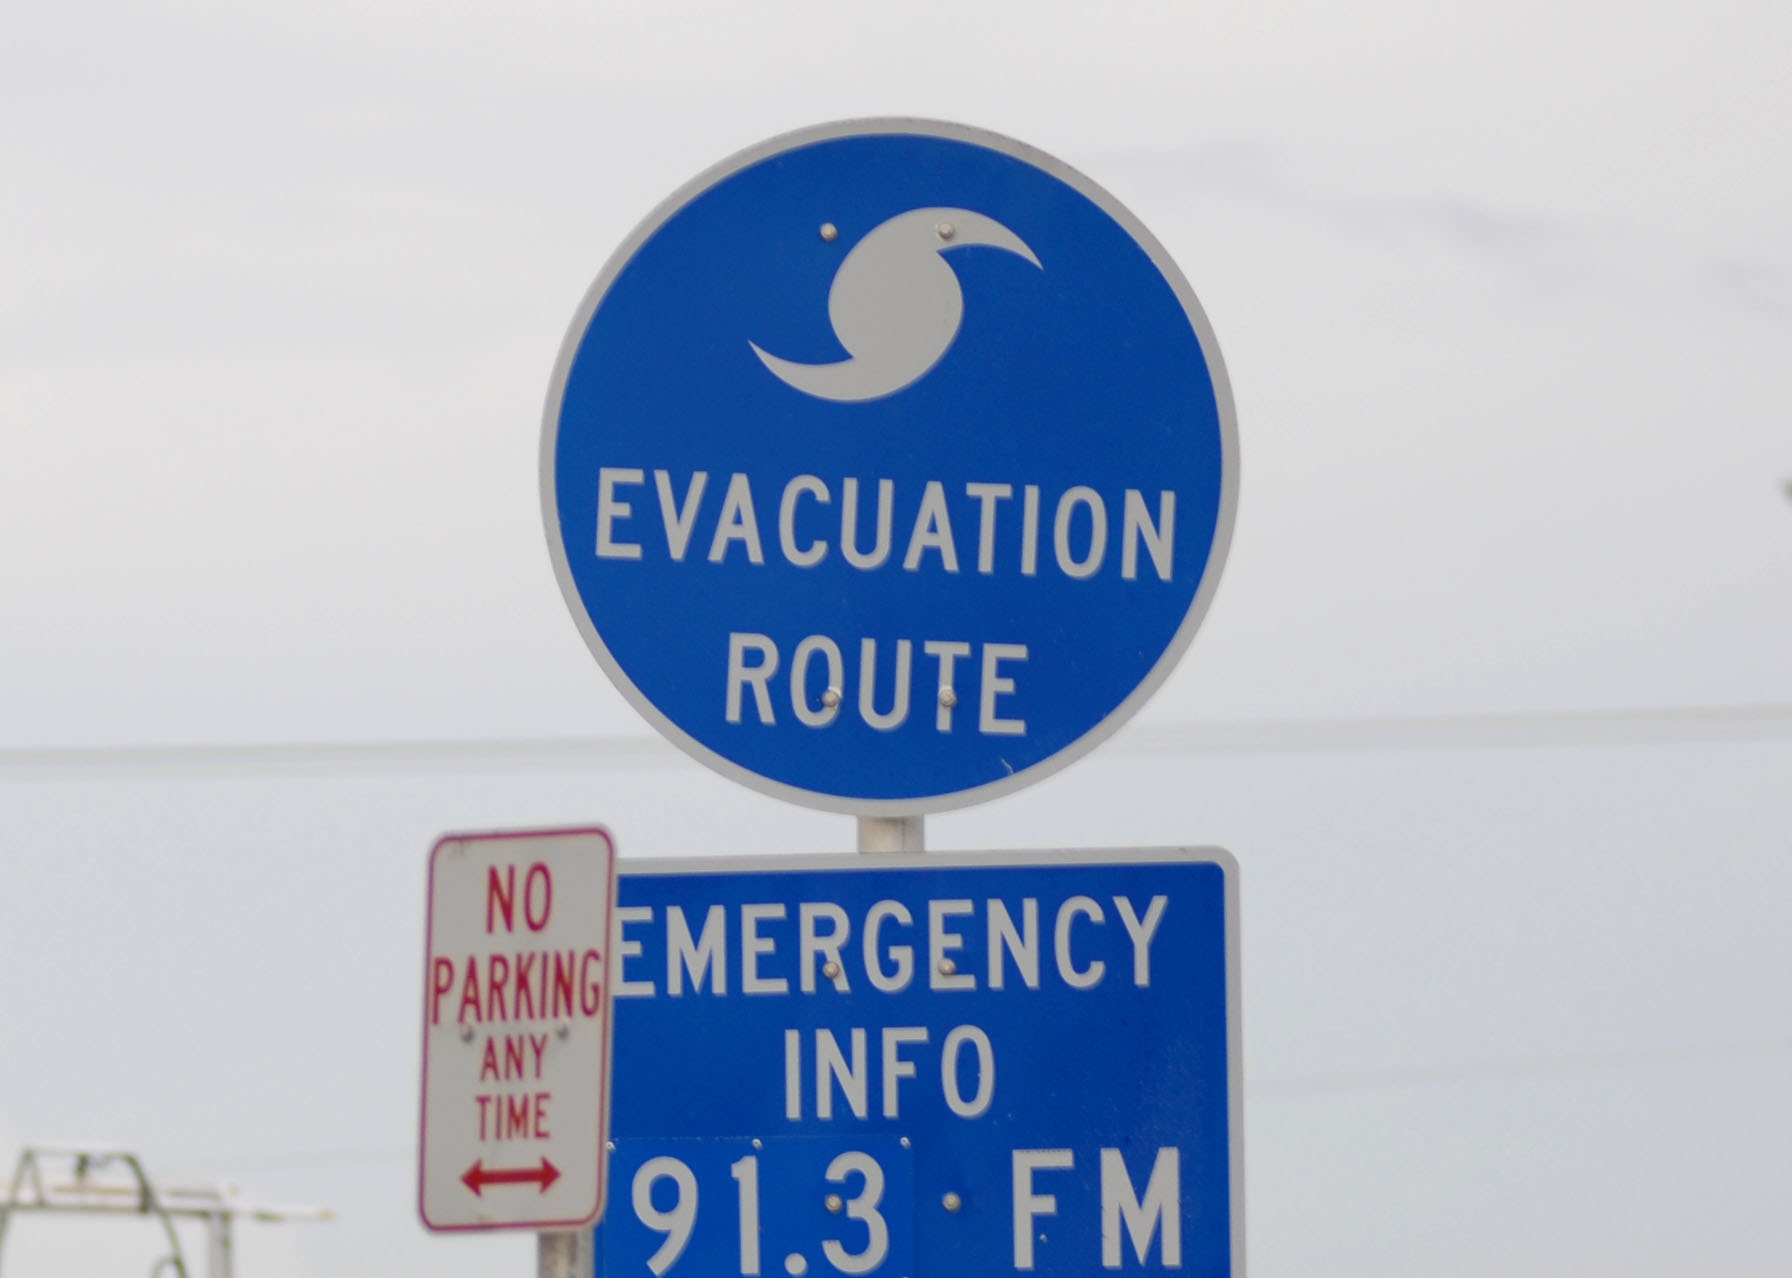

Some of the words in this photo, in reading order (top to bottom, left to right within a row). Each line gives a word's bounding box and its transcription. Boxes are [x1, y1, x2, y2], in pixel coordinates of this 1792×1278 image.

[595, 466, 1177, 583] EVACUATION
[724, 631, 1030, 736] ROUTE
[485, 861, 553, 935] NO
[612, 894, 1169, 998] EMERGENCY
[431, 948, 602, 1026] PARKING
[479, 1033, 548, 1082] ANY
[784, 1024, 996, 1121] INFO
[474, 1092, 552, 1142] TIME
[630, 1150, 890, 1278] 91.3
[1012, 1146, 1183, 1270] FM
